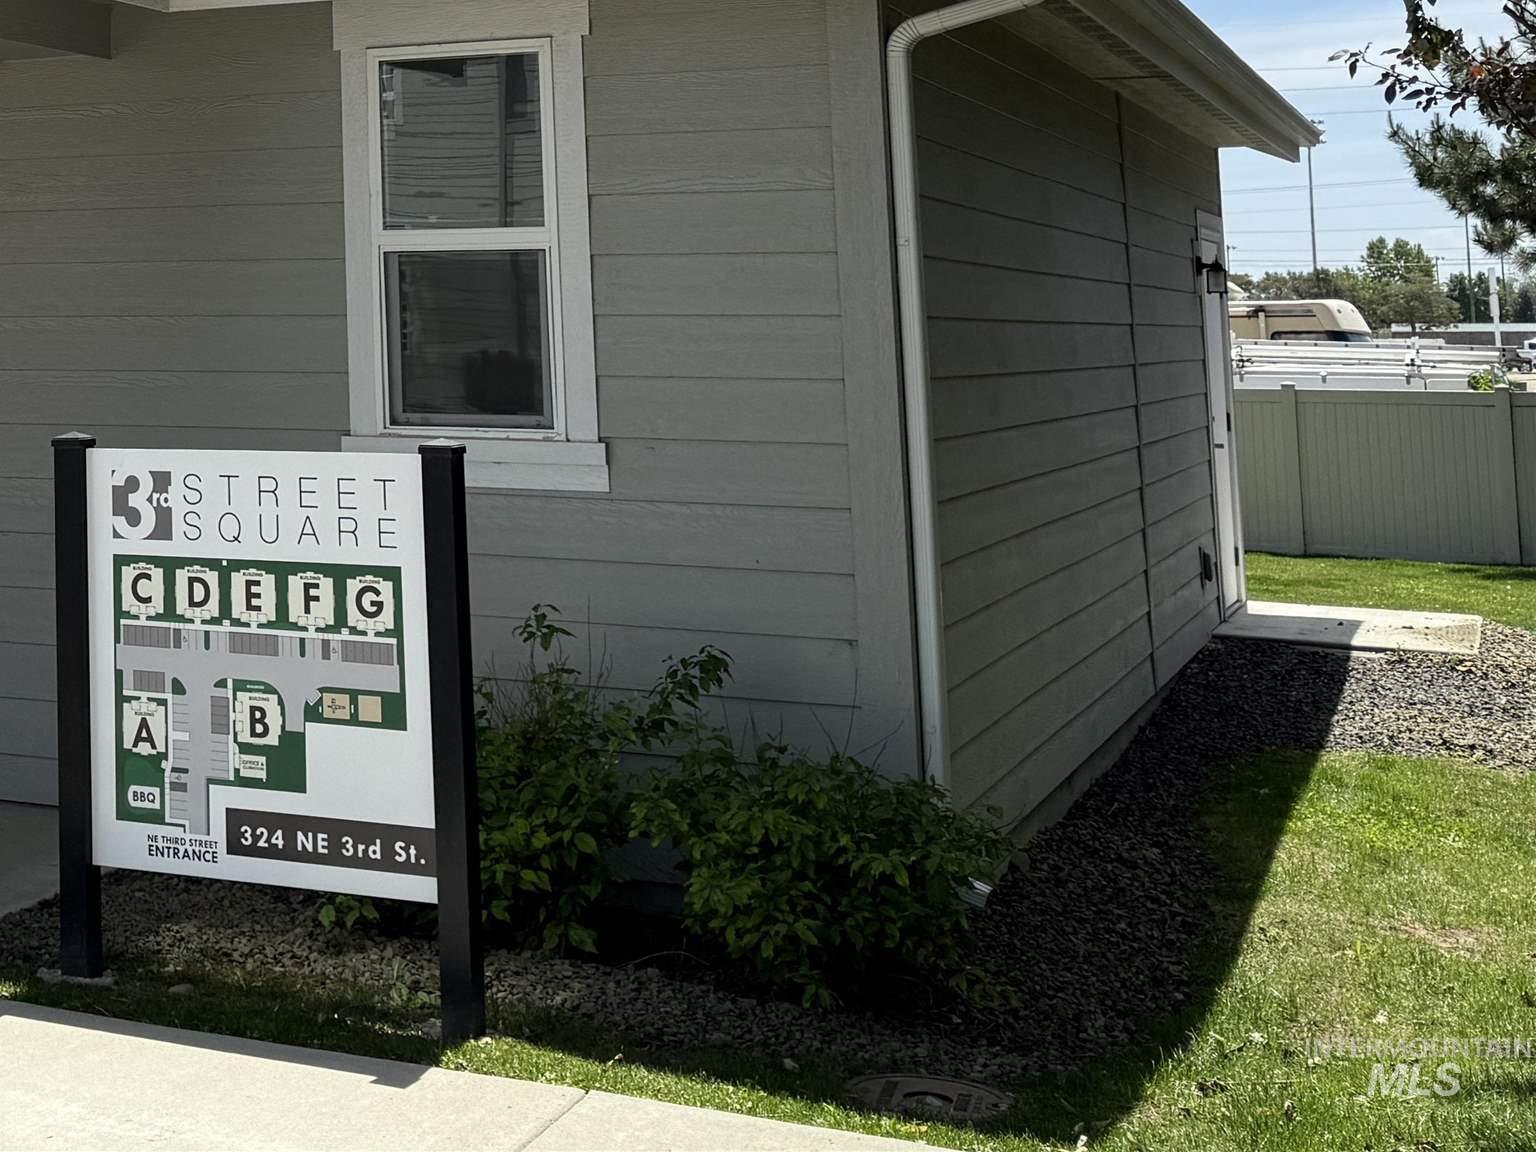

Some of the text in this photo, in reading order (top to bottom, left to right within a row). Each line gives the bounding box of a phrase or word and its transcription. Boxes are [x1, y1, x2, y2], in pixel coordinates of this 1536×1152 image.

[183, 473, 396, 511] STREET
[183, 510, 398, 549] SQUARE
[131, 572, 384, 619] C D E F G
[132, 717, 157, 750] A
[249, 705, 270, 738] B
[132, 791, 156, 804] BBQ
[147, 834, 218, 849] NE THIRD STREET
[148, 844, 218, 863] ENTRANCE
[240, 825, 426, 865] 324 NE 3rd St.
